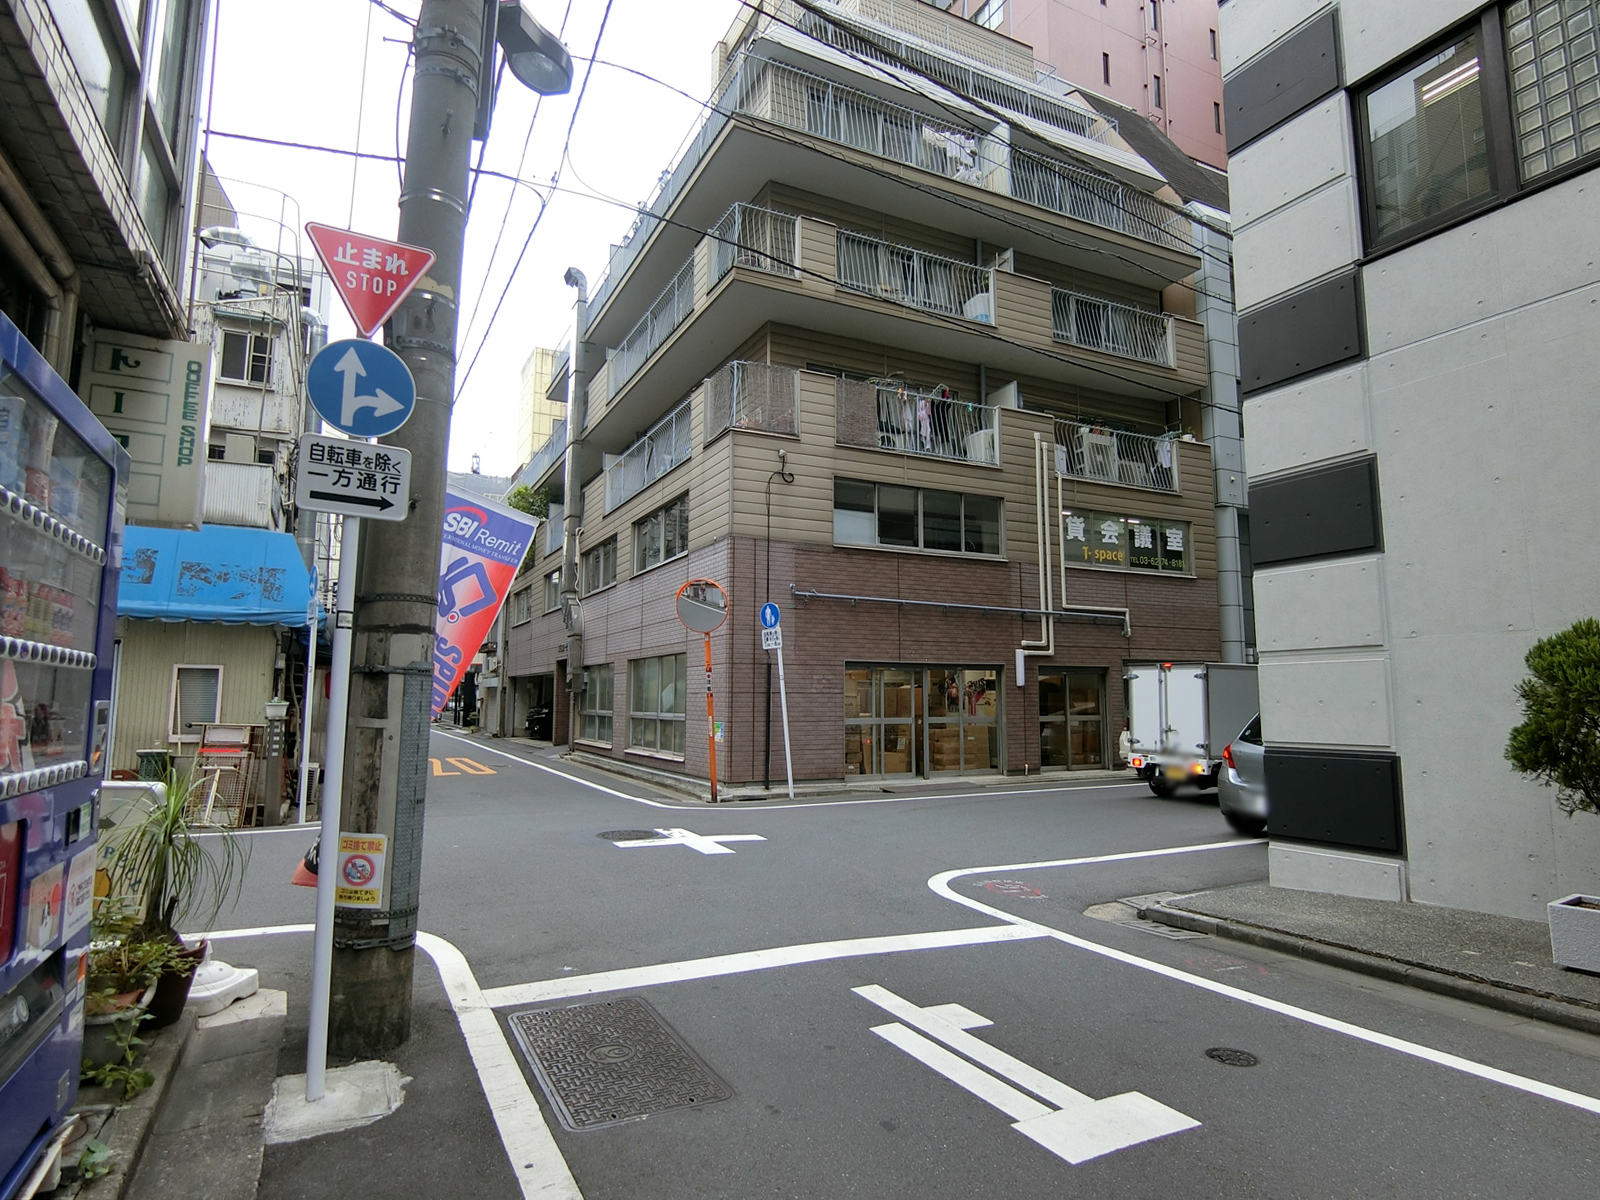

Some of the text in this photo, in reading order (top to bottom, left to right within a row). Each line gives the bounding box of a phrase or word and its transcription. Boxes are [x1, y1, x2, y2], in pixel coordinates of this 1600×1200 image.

[333, 241, 409, 276] 止まれ
[346, 270, 398, 297] STOP
[177, 360, 203, 467] COFFEE SHOP
[308, 442, 402, 474] 自転車を除く
[307, 468, 401, 495] 一方通行
[443, 512, 522, 556] SBI Remit
[1065, 515, 1184, 552] 貸会議室
[471, 542, 492, 555] MONEY
[491, 550, 519, 565] TRANSFER
[1130, 556, 1140, 564] TEL
